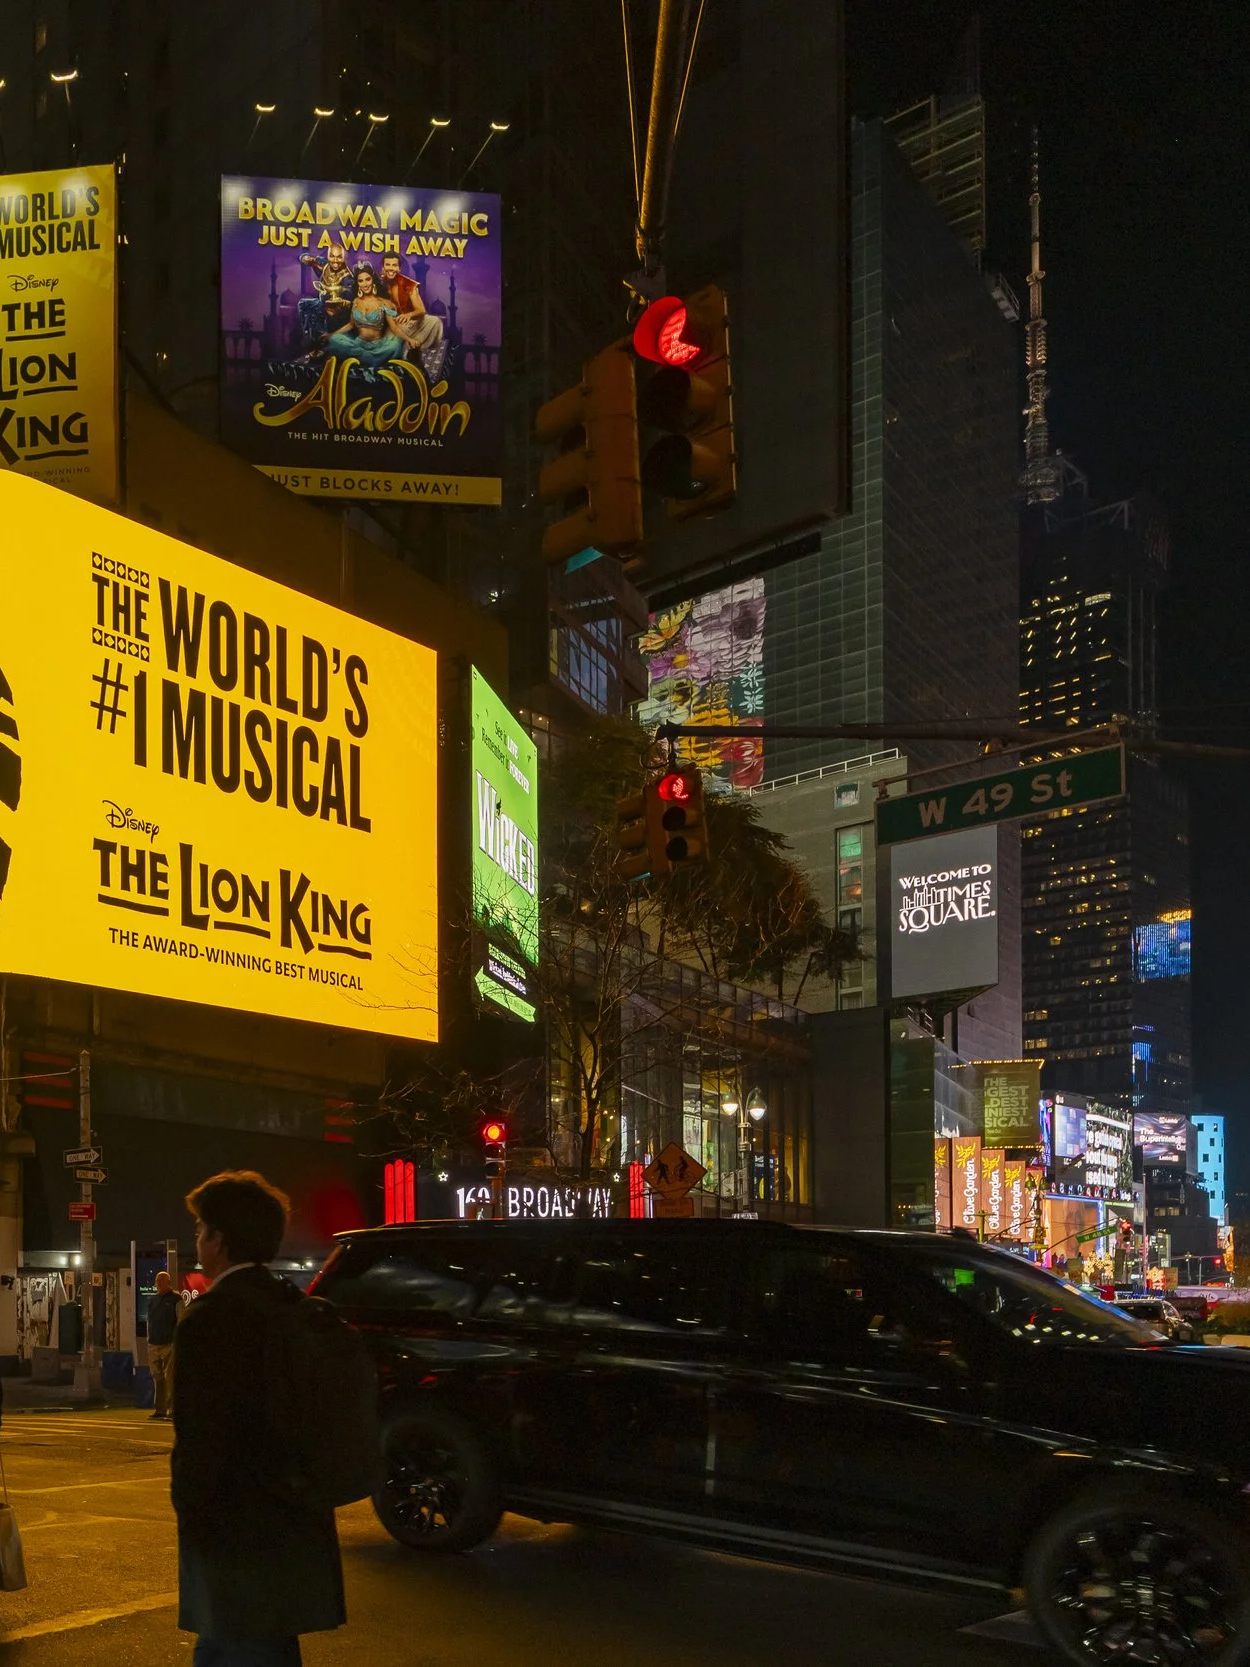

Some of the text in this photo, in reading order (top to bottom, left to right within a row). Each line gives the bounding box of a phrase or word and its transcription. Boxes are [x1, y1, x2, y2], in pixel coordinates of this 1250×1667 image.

[238, 197, 490, 237] BROADWAY MAGIC
[258, 225, 469, 258] JUST A WISH AWAY
[1, 298, 66, 332] THE
[253, 355, 472, 437] Aladdin
[287, 431, 444, 447] THE HIT BROADWAY MUSICAL
[319, 475, 393, 492] BLOCKS
[400, 481, 460, 497] AWAY!
[91, 572, 369, 739] THE WORLD'S
[90, 657, 372, 833] #1 MUSICAL
[481, 726, 505, 766] Remember
[509, 759, 530, 795] FOREVER
[918, 768, 1073, 829] W 49 St
[475, 768, 535, 898] WICKED
[92, 837, 373, 956] THE LION KING
[898, 864, 992, 890] WELCOME TO
[937, 879, 992, 903] TIMES
[108, 926, 364, 992] THE AWARD-WINNING BEST MUSICAL
[985, 1117, 1030, 1128] SICAL
[963, 1157, 978, 1224] Olive Garden
[988, 1169, 1003, 1204] Garden
[1010, 1179, 1023, 1211] Garden
